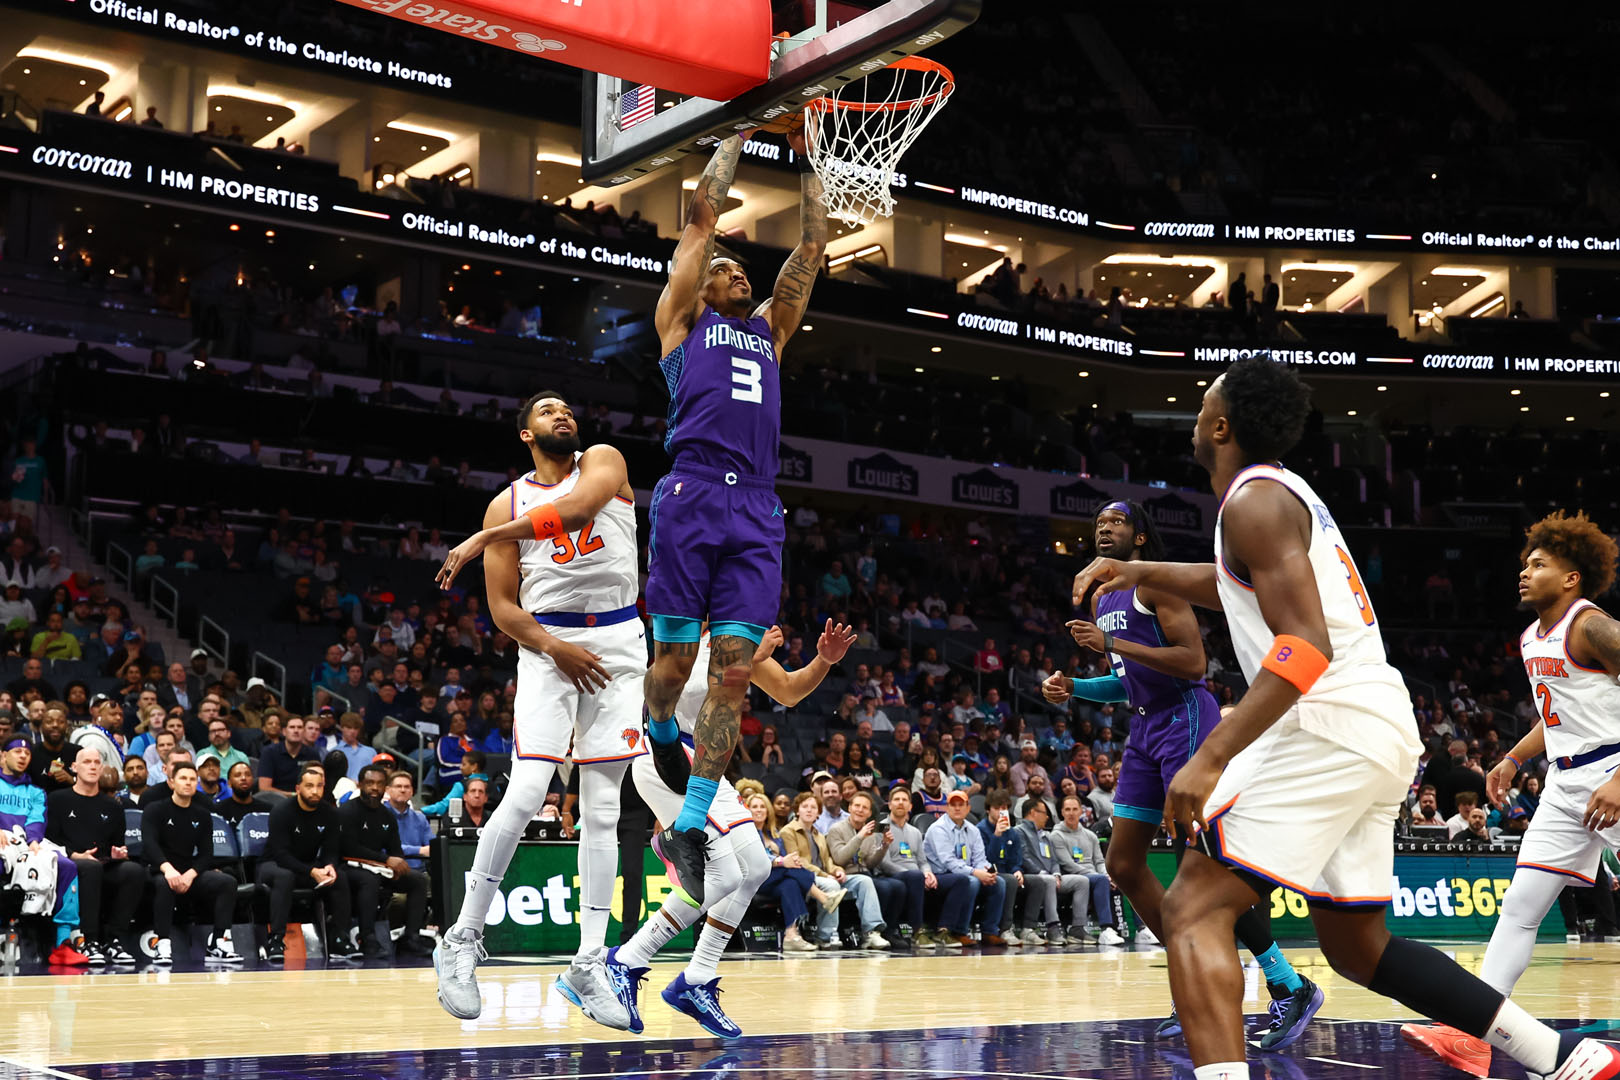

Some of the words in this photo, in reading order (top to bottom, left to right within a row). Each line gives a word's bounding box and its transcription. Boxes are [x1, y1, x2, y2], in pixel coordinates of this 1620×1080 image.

[90, 0, 158, 25] Official
[245, 31, 264, 47] of
[268, 36, 297, 55] the
[303, 43, 382, 74] Charlotte
[388, 61, 452, 89] Hornets
[915, 31, 944, 46] ally
[859, 58, 888, 72] ally
[801, 84, 828, 96] ally
[763, 105, 789, 119] ally
[32, 145, 132, 180] corcoran
[161, 168, 194, 191] HM
[201, 176, 319, 213] PROPERTIES
[961, 186, 1089, 226] HMPROPERTIES.COM
[402, 212, 463, 237] Official
[539, 238, 557, 253] of
[561, 242, 587, 259] the
[591, 246, 663, 273] Charlotte
[1144, 222, 1215, 238] corcoran
[1235, 226, 1260, 239] HM
[1265, 226, 1356, 243] PROPERTIES
[1422, 231, 1473, 246] Official
[1538, 235, 1553, 248] of
[1557, 236, 1579, 249] the
[957, 312, 1018, 336] corcoran
[704, 323, 773, 363] HORNETS
[1035, 326, 1056, 342] HM
[1059, 331, 1134, 357] PROPERTIES
[1194, 347, 1356, 366] HMPRORTIES.COM
[1422, 351, 1494, 371] corcoran
[1514, 357, 1540, 372] HM
[1544, 358, 1620, 374] PROPERTI
[730, 356, 763, 405] 3
[855, 465, 912, 492] LOWE'S
[959, 479, 1013, 505] LOWE'S
[550, 520, 606, 565] 32
[1276, 646, 1292, 663] 8
[1536, 682, 1562, 728] 2
[1391, 876, 1511, 918] bet365
